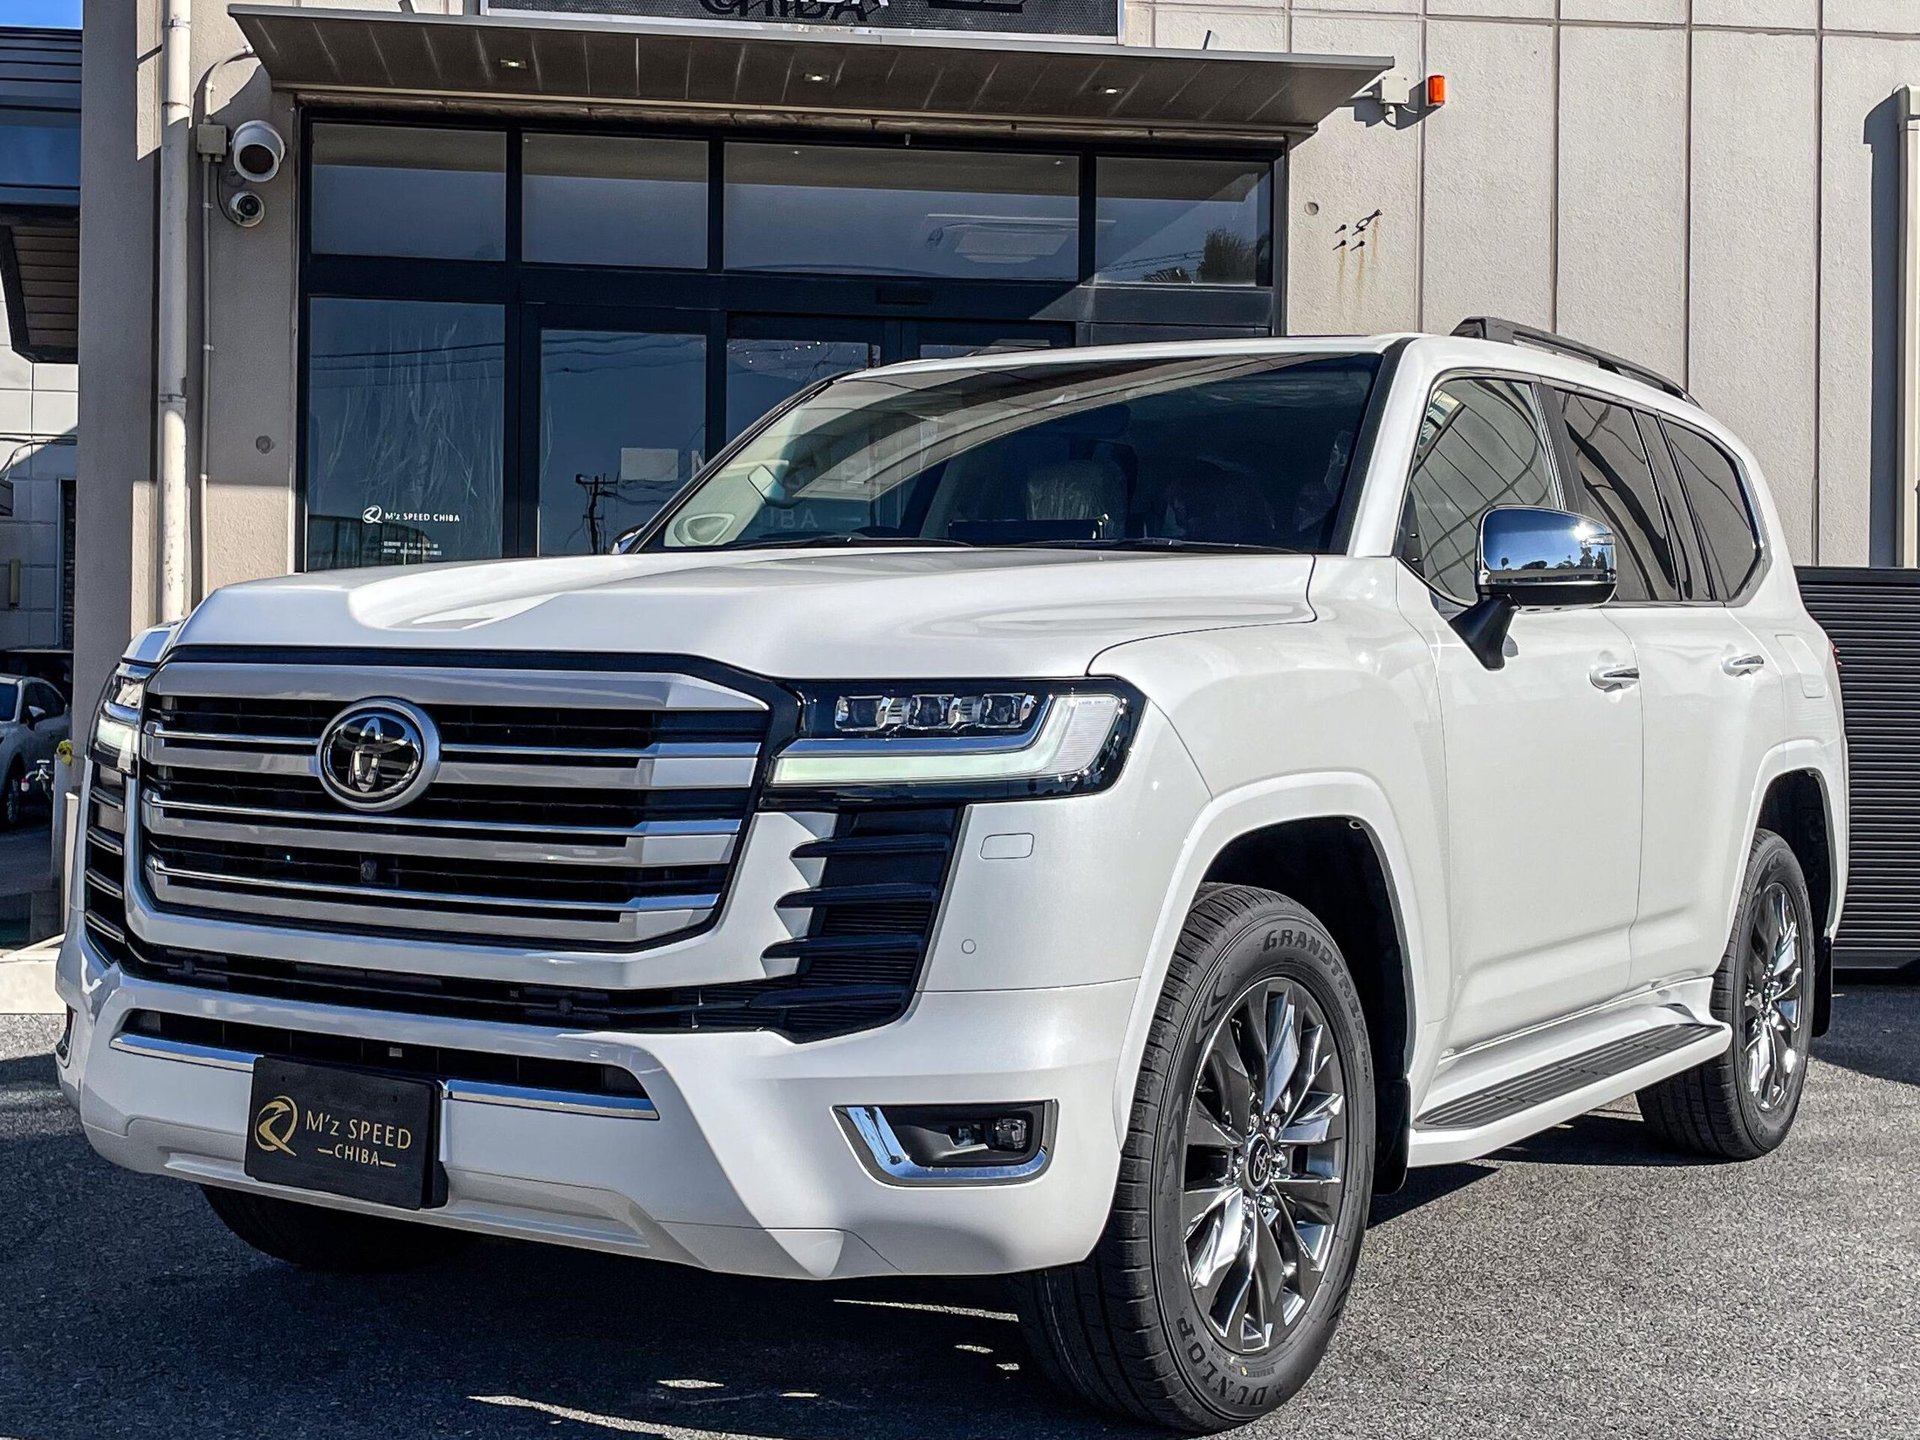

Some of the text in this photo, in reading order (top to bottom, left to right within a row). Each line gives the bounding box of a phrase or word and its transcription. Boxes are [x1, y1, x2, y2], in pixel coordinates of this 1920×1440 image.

[403, 512, 430, 521] SPEED
[433, 513, 460, 522] CHIBA
[348, 1119, 411, 1149] SPEED
[1176, 1317, 1269, 1406] DUNLOP
